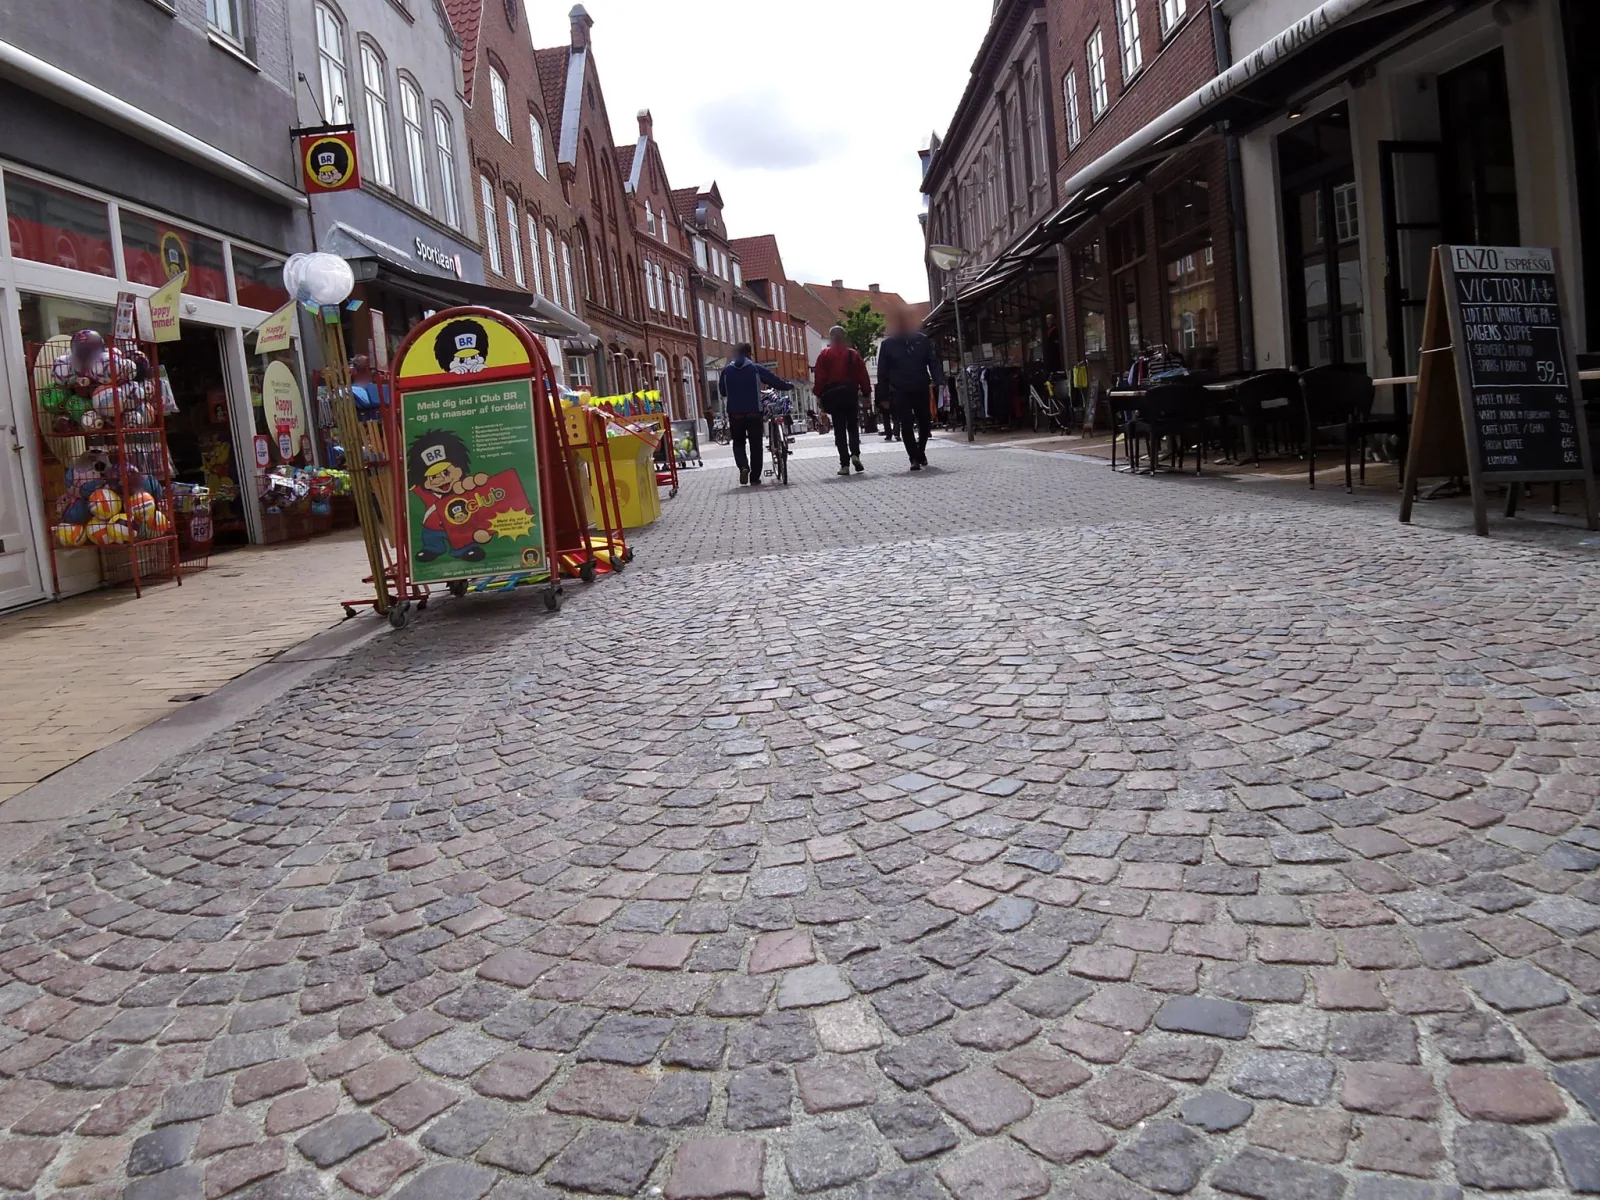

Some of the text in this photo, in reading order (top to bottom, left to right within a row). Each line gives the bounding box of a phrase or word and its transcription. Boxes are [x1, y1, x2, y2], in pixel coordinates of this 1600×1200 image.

[320, 155, 332, 164] BR
[415, 236, 456, 272] Sportigan
[1456, 248, 1551, 271] ENZO ESPRESSO
[1460, 278, 1540, 302] VICTORIA
[152, 316, 175, 328] mmer!
[1462, 307, 1480, 322] LIDT
[1482, 307, 1493, 322] AT
[1494, 307, 1522, 323] VARME
[1524, 307, 1538, 323] DIG
[260, 331, 287, 344] Summer!
[265, 324, 284, 338] Happy
[1465, 324, 1533, 341] DAGENS SUPPE
[458, 336, 474, 347] BR
[274, 396, 293, 416] Happy
[417, 401, 440, 411] Meld
[442, 398, 457, 409] dig
[459, 396, 473, 406] ind
[480, 393, 501, 403] Club
[503, 391, 517, 400] BR
[416, 413, 428, 423] og
[430, 409, 440, 420] få
[442, 407, 477, 418] masser
[479, 404, 488, 414] af
[491, 401, 527, 412] fordele!
[425, 448, 443, 463] BR
[466, 487, 506, 513] club
